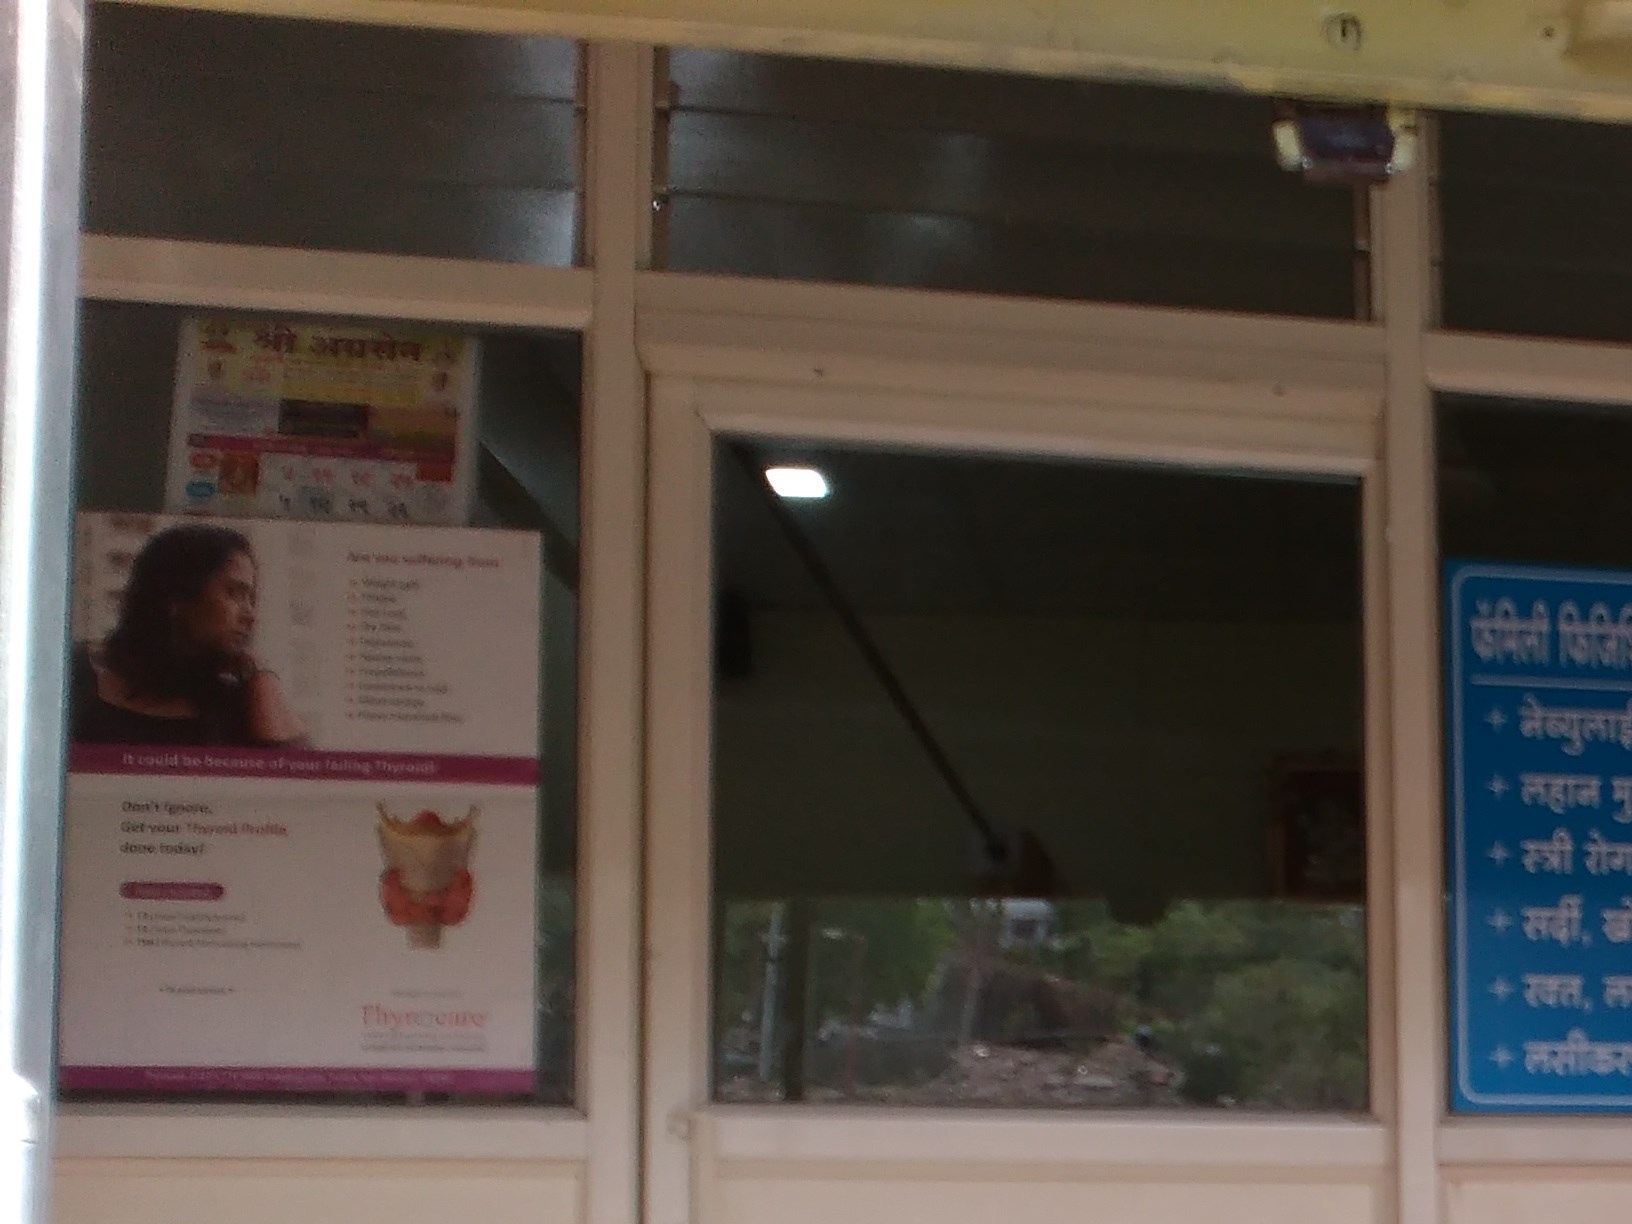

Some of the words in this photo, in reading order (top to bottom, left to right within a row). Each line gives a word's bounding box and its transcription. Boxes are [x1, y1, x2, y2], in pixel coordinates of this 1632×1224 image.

[138, 753, 178, 767] could
[204, 754, 265, 769] because
[1521, 773, 1601, 813] लहान
